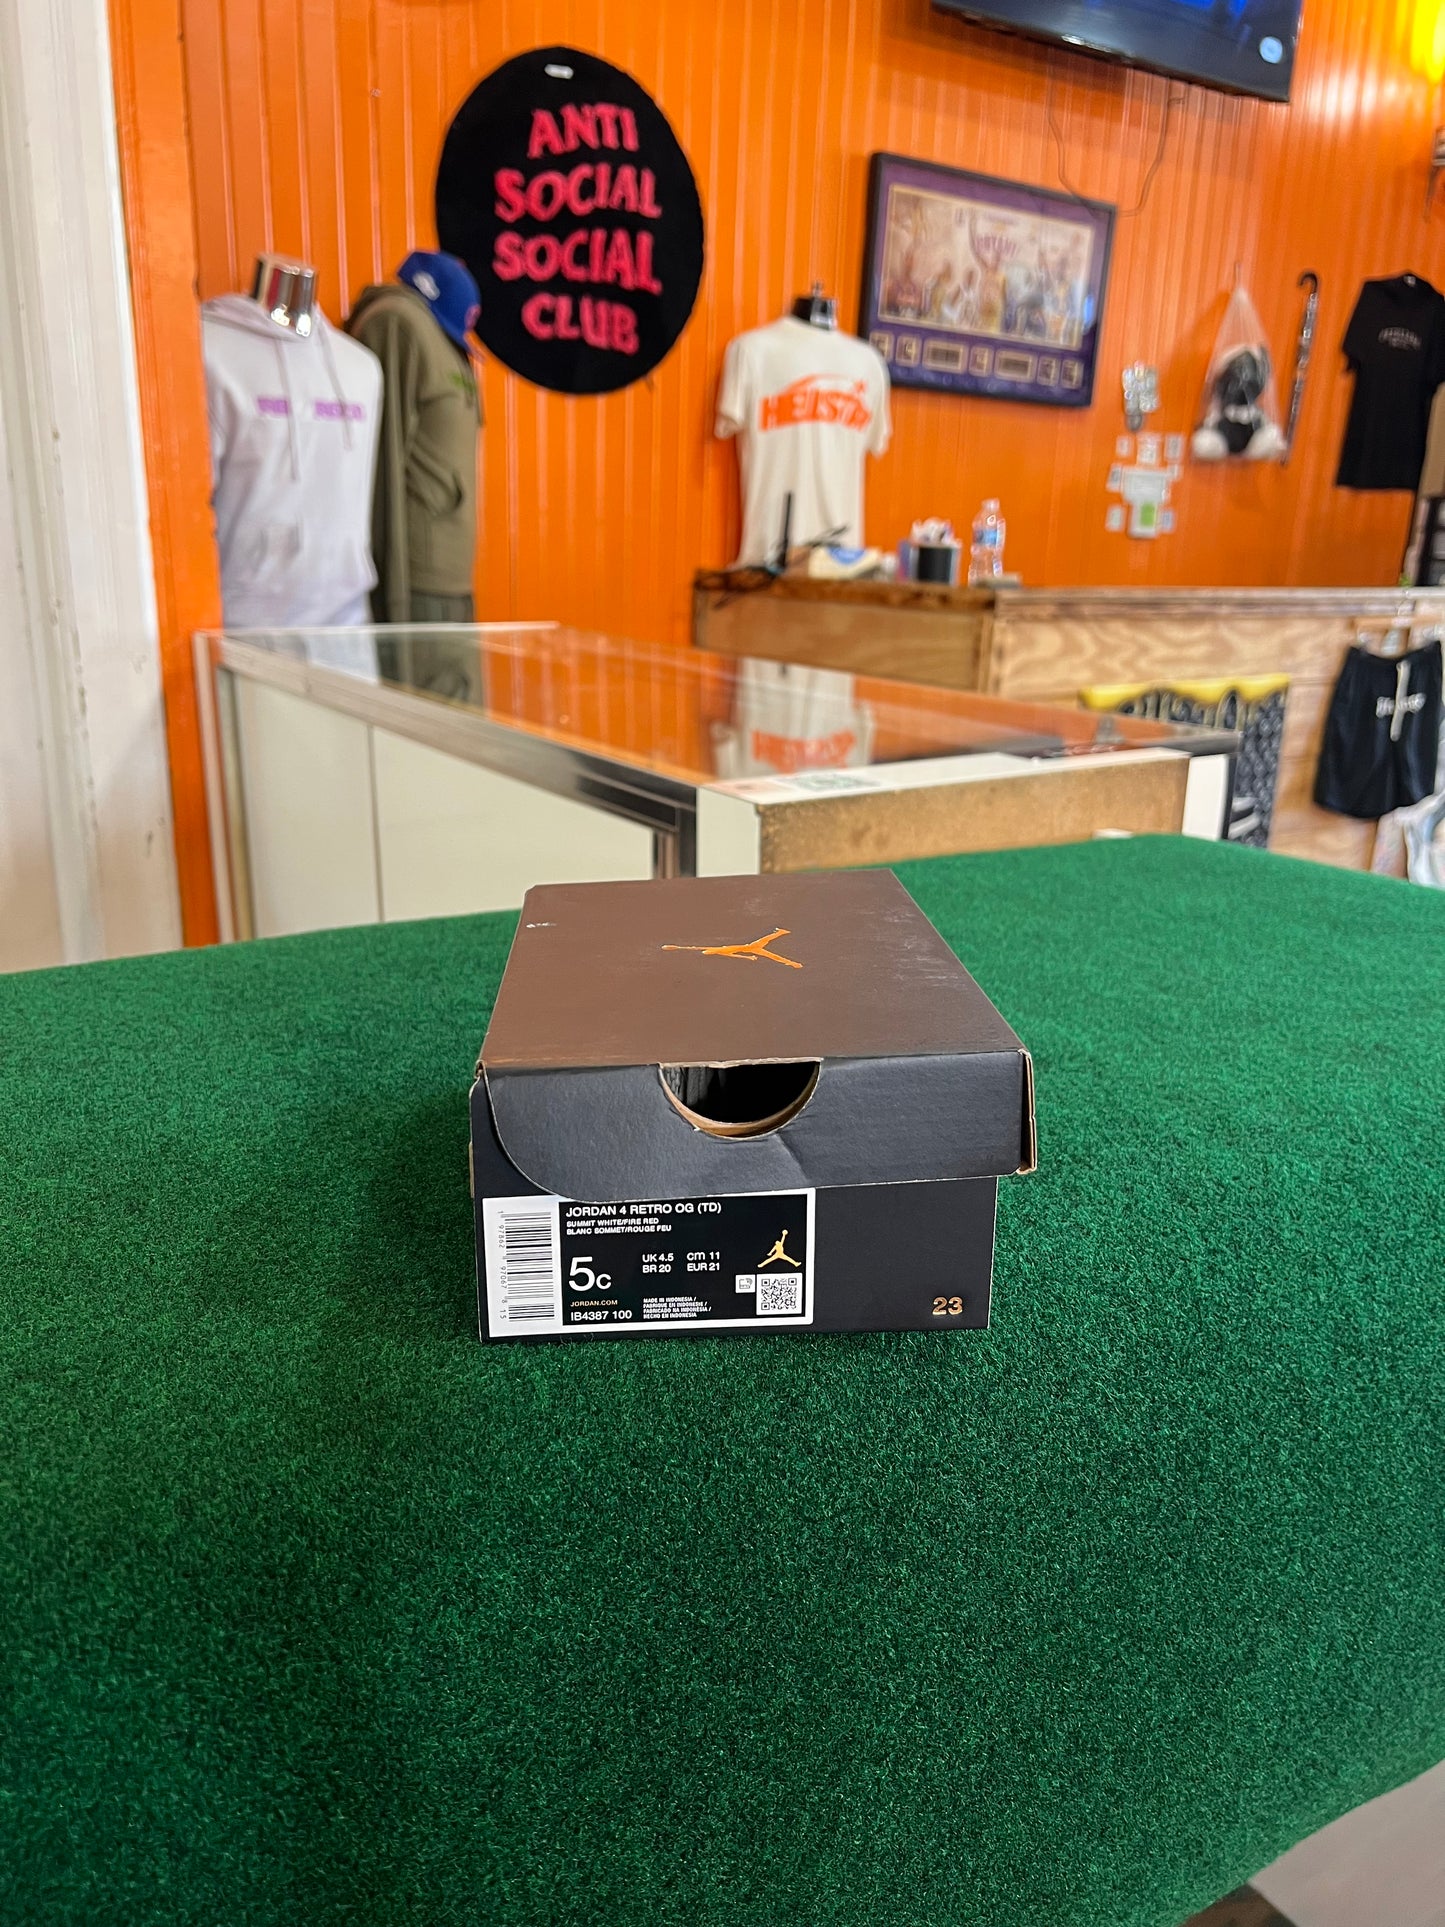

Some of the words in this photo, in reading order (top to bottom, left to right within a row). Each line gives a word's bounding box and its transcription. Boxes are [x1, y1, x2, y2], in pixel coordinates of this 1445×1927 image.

[527, 103, 639, 159] ANTI
[494, 162, 662, 223] SOCIAL
[493, 227, 663, 295] SOCIAL
[521, 292, 640, 355] CLUB
[565, 1205, 617, 1217] JORDAN
[619, 1205, 627, 1215] 4
[630, 1203, 672, 1215] RETRO
[675, 1203, 694, 1214] OG
[697, 1202, 722, 1214] (TD)
[566, 1219, 596, 1227] SUMMIT
[597, 1217, 641, 1226] WHITE/FIRE
[643, 1217, 659, 1225] RED
[566, 1227, 592, 1235] BLANC
[594, 1225, 655, 1234] SOMMET/ROUGE
[656, 1224, 672, 1232] FEU
[642, 1253, 657, 1263] UK
[658, 1252, 674, 1262] 4.5
[709, 1251, 720, 1260] 11
[642, 1264, 657, 1273] BR
[658, 1264, 671, 1273] 20
[686, 1263, 708, 1272] EUR
[708, 1262, 720, 1271] 21
[570, 1300, 618, 1308] JORDAN.COM
[932, 1296, 963, 1316] 23
[570, 1310, 609, 1321] IB4387
[612, 1309, 633, 1320] 100
